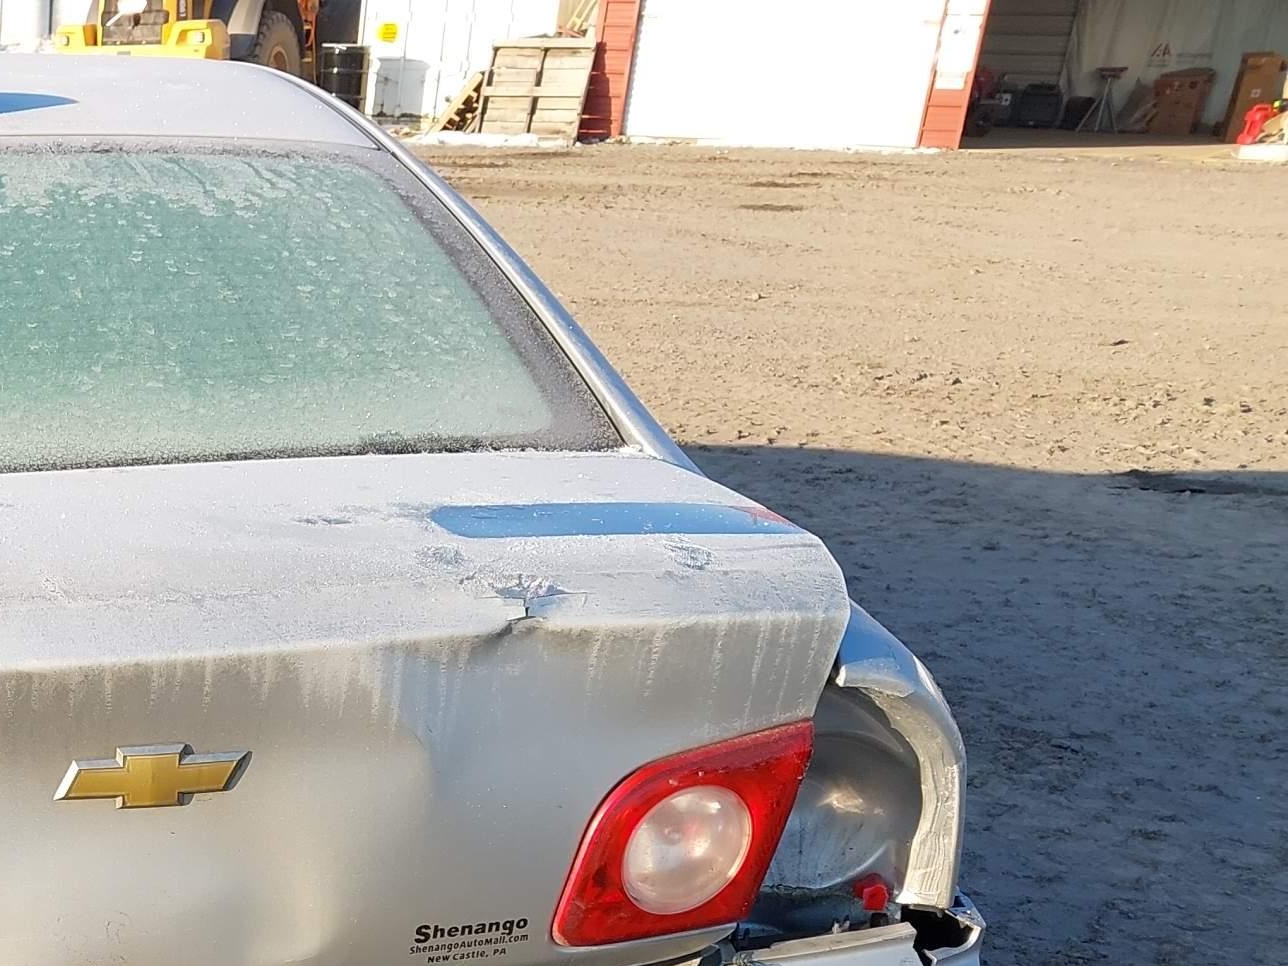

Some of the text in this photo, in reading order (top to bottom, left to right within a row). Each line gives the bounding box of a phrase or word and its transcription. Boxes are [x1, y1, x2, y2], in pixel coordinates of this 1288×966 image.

[414, 918, 529, 944] Shenango
[409, 934, 529, 955] ShenangoAutoMall.com
[427, 954, 451, 964] New
[493, 948, 507, 956] PA
